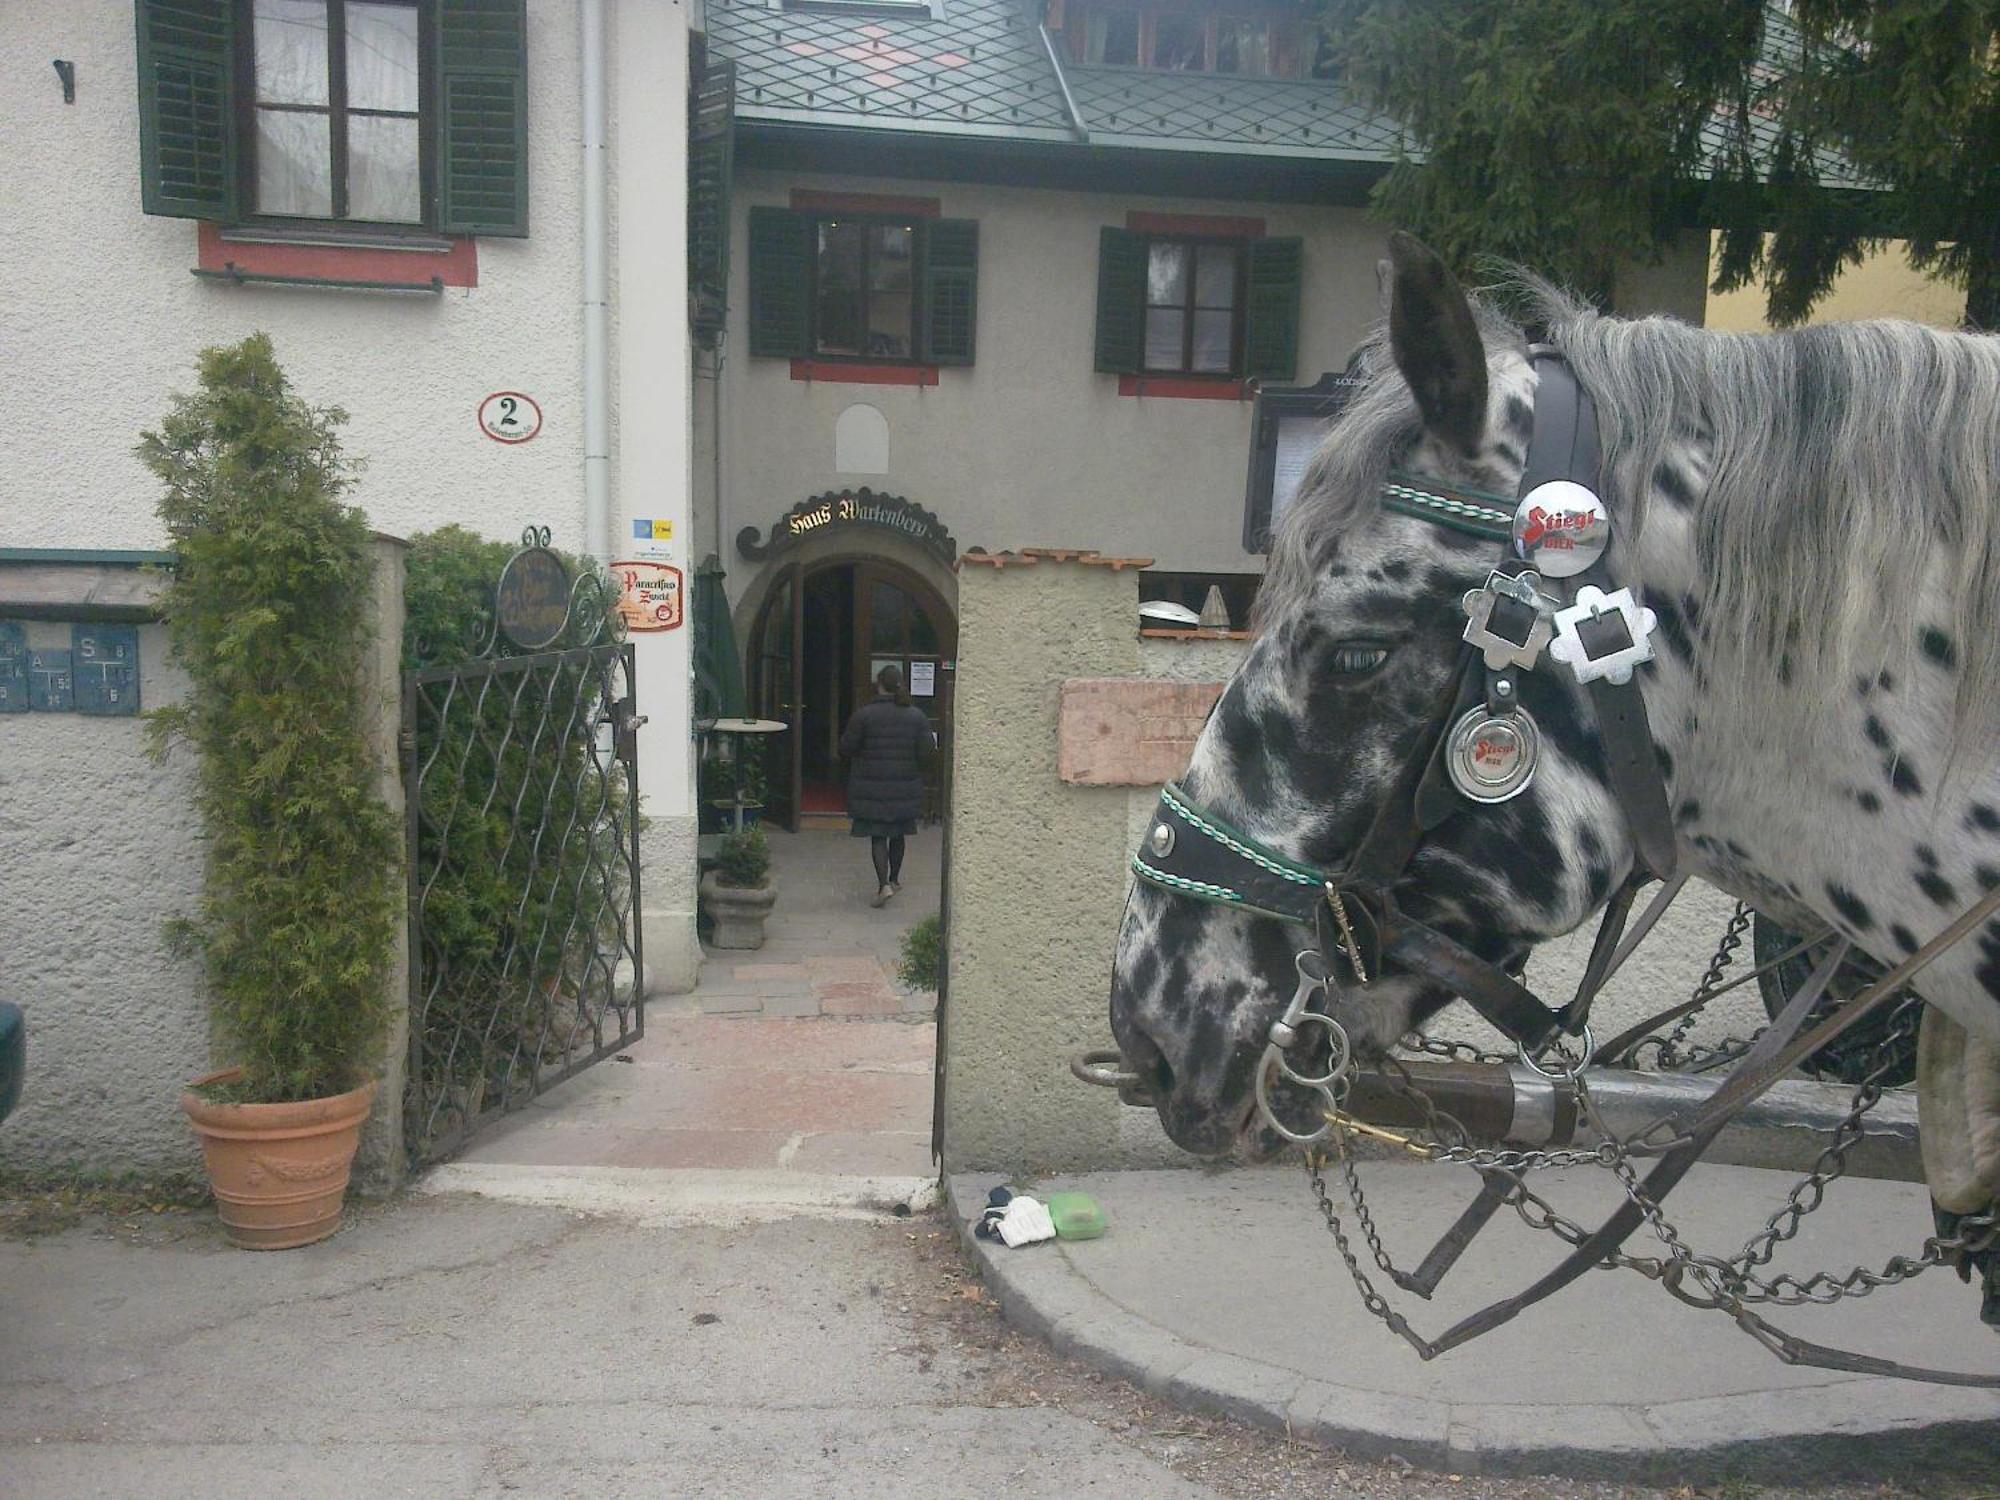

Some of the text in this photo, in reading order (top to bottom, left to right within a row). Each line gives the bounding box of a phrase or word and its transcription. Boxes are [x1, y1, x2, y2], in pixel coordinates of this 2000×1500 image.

[500, 397, 518, 425] 2
[789, 498, 928, 537] Haus Wartenberg
[1523, 505, 1597, 545] Stiegl
[32, 655, 43, 667] A
[80, 637, 96, 658] S
